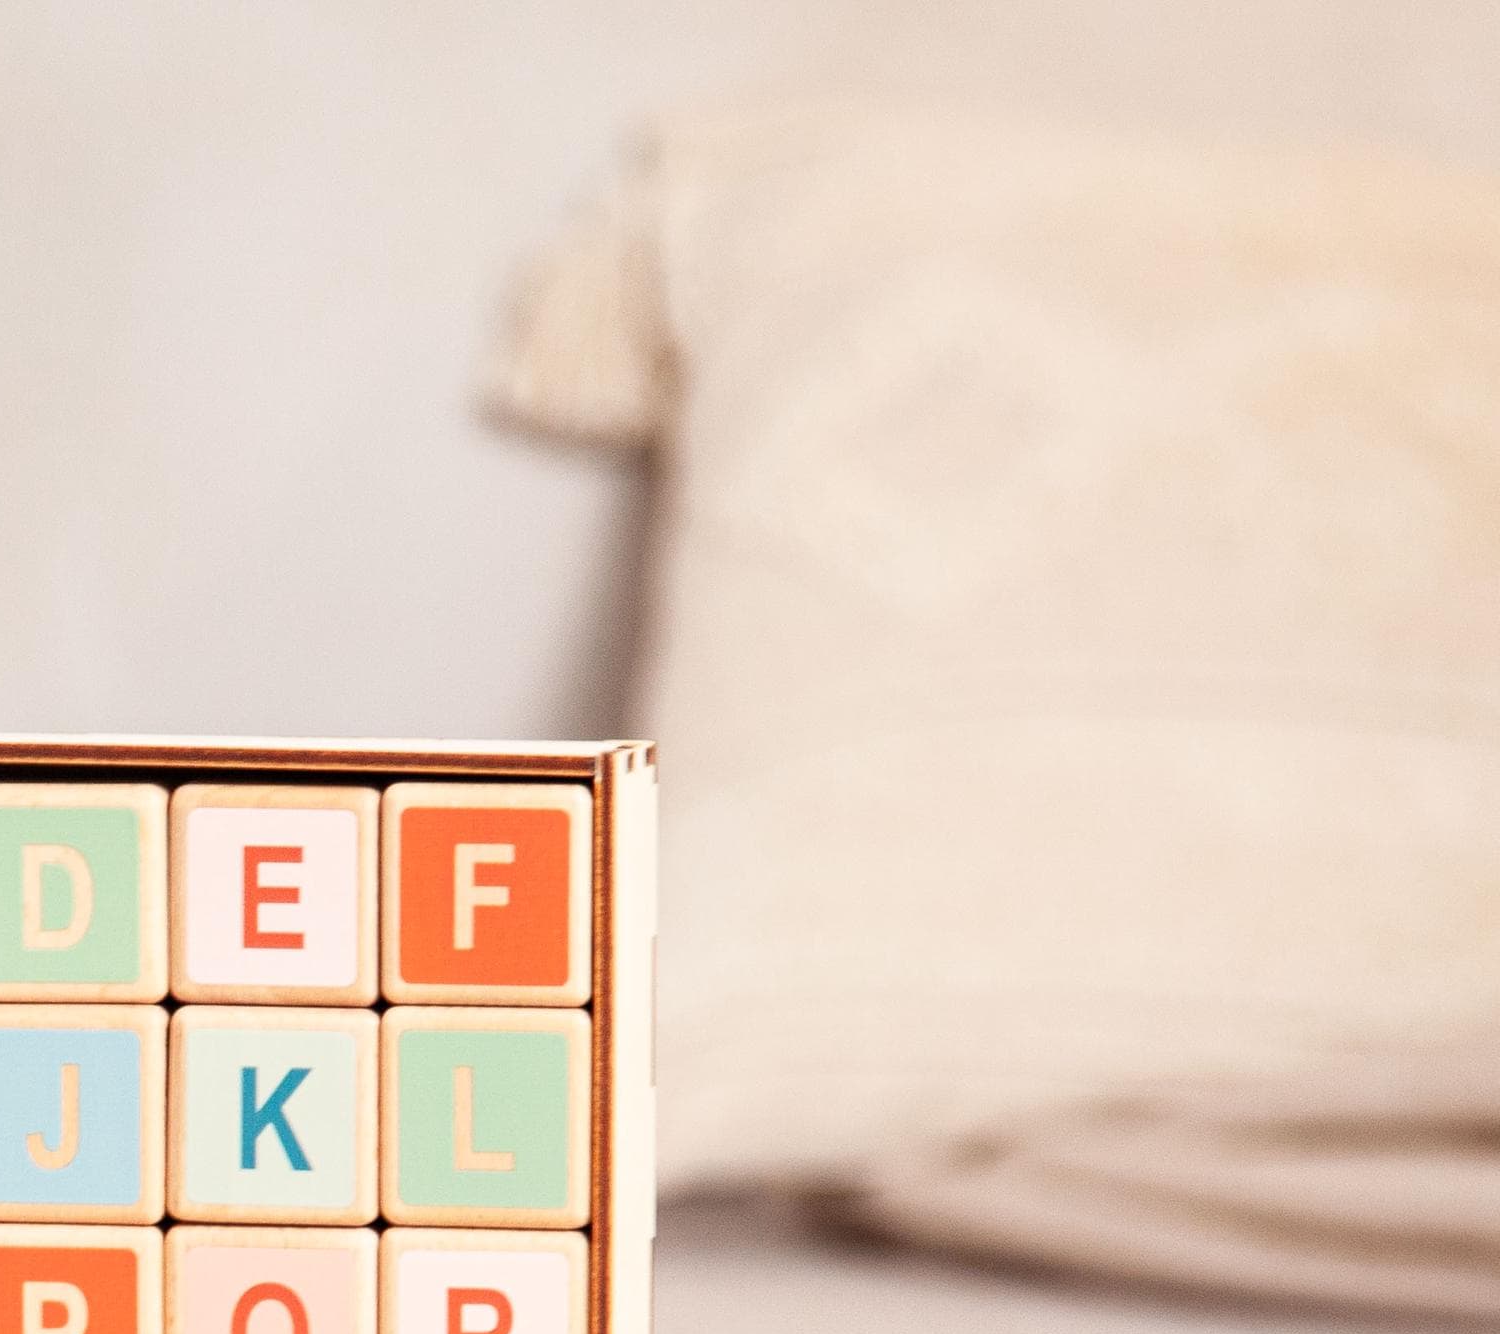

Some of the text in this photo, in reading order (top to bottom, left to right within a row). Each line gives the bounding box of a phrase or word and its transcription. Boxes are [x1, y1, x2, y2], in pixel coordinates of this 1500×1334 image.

[22, 842, 95, 951] D
[242, 845, 305, 950] E
[453, 842, 516, 950] F
[26, 1063, 80, 1170] J
[240, 1066, 312, 1172] K
[452, 1064, 516, 1173] L
